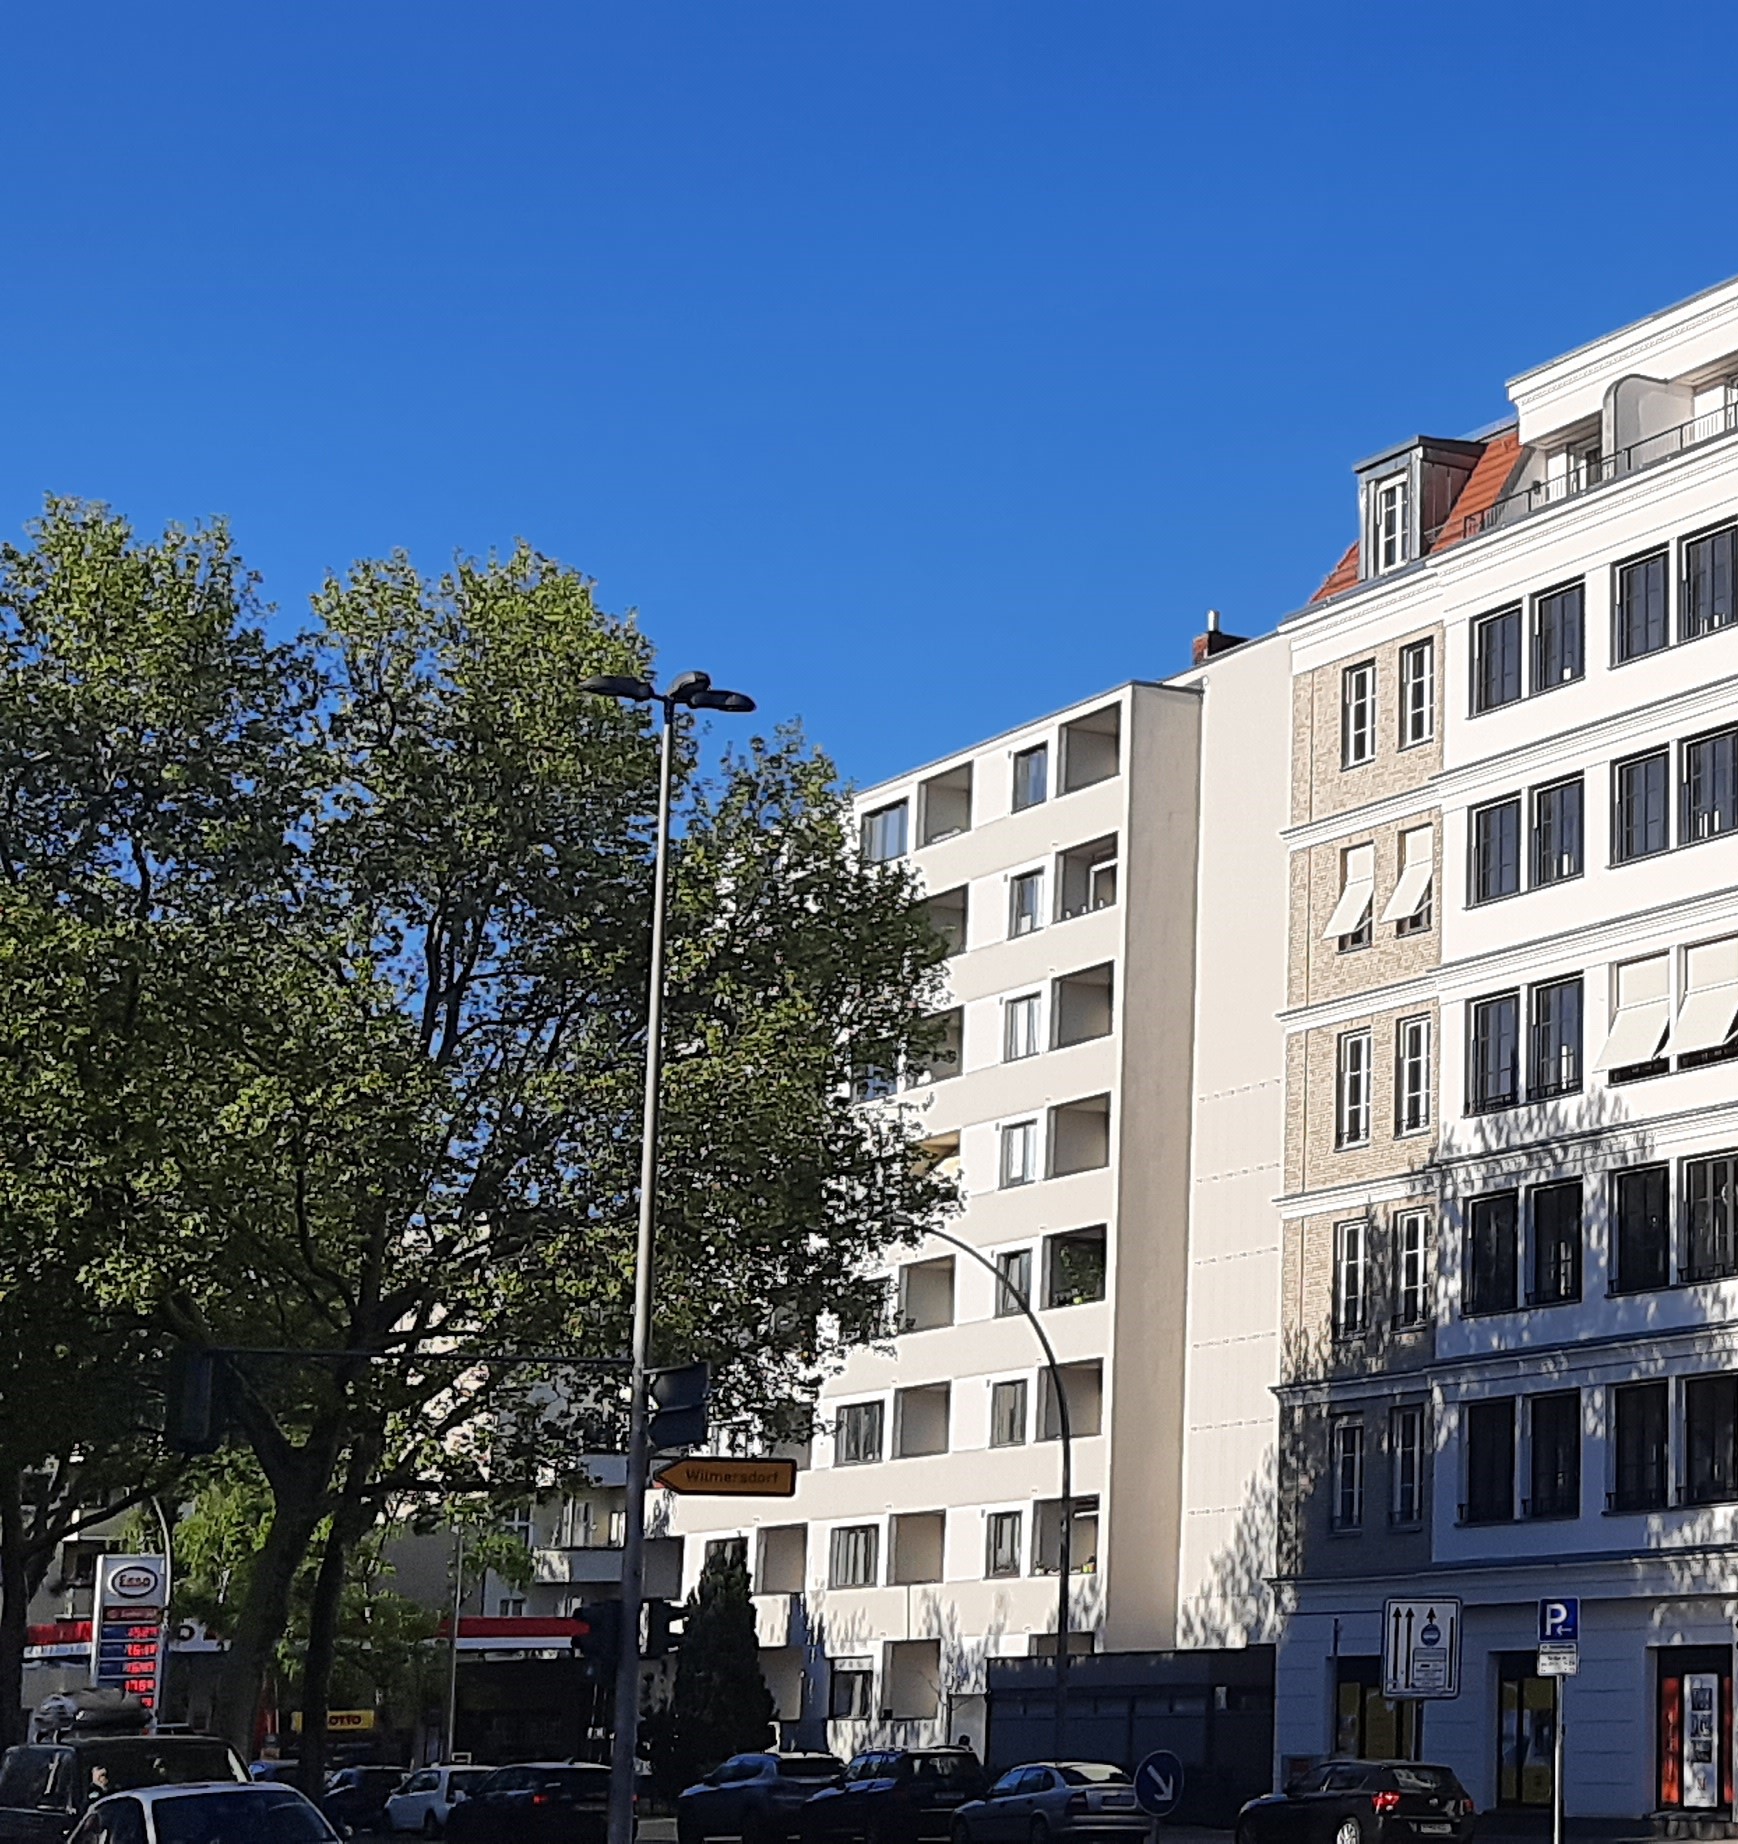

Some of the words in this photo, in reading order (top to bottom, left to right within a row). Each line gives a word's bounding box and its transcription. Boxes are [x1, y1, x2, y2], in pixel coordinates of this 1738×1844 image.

[685, 1469, 779, 1485] Wilmersdorf
[119, 1574, 151, 1588] Esso
[1545, 1603, 1568, 1636] P
